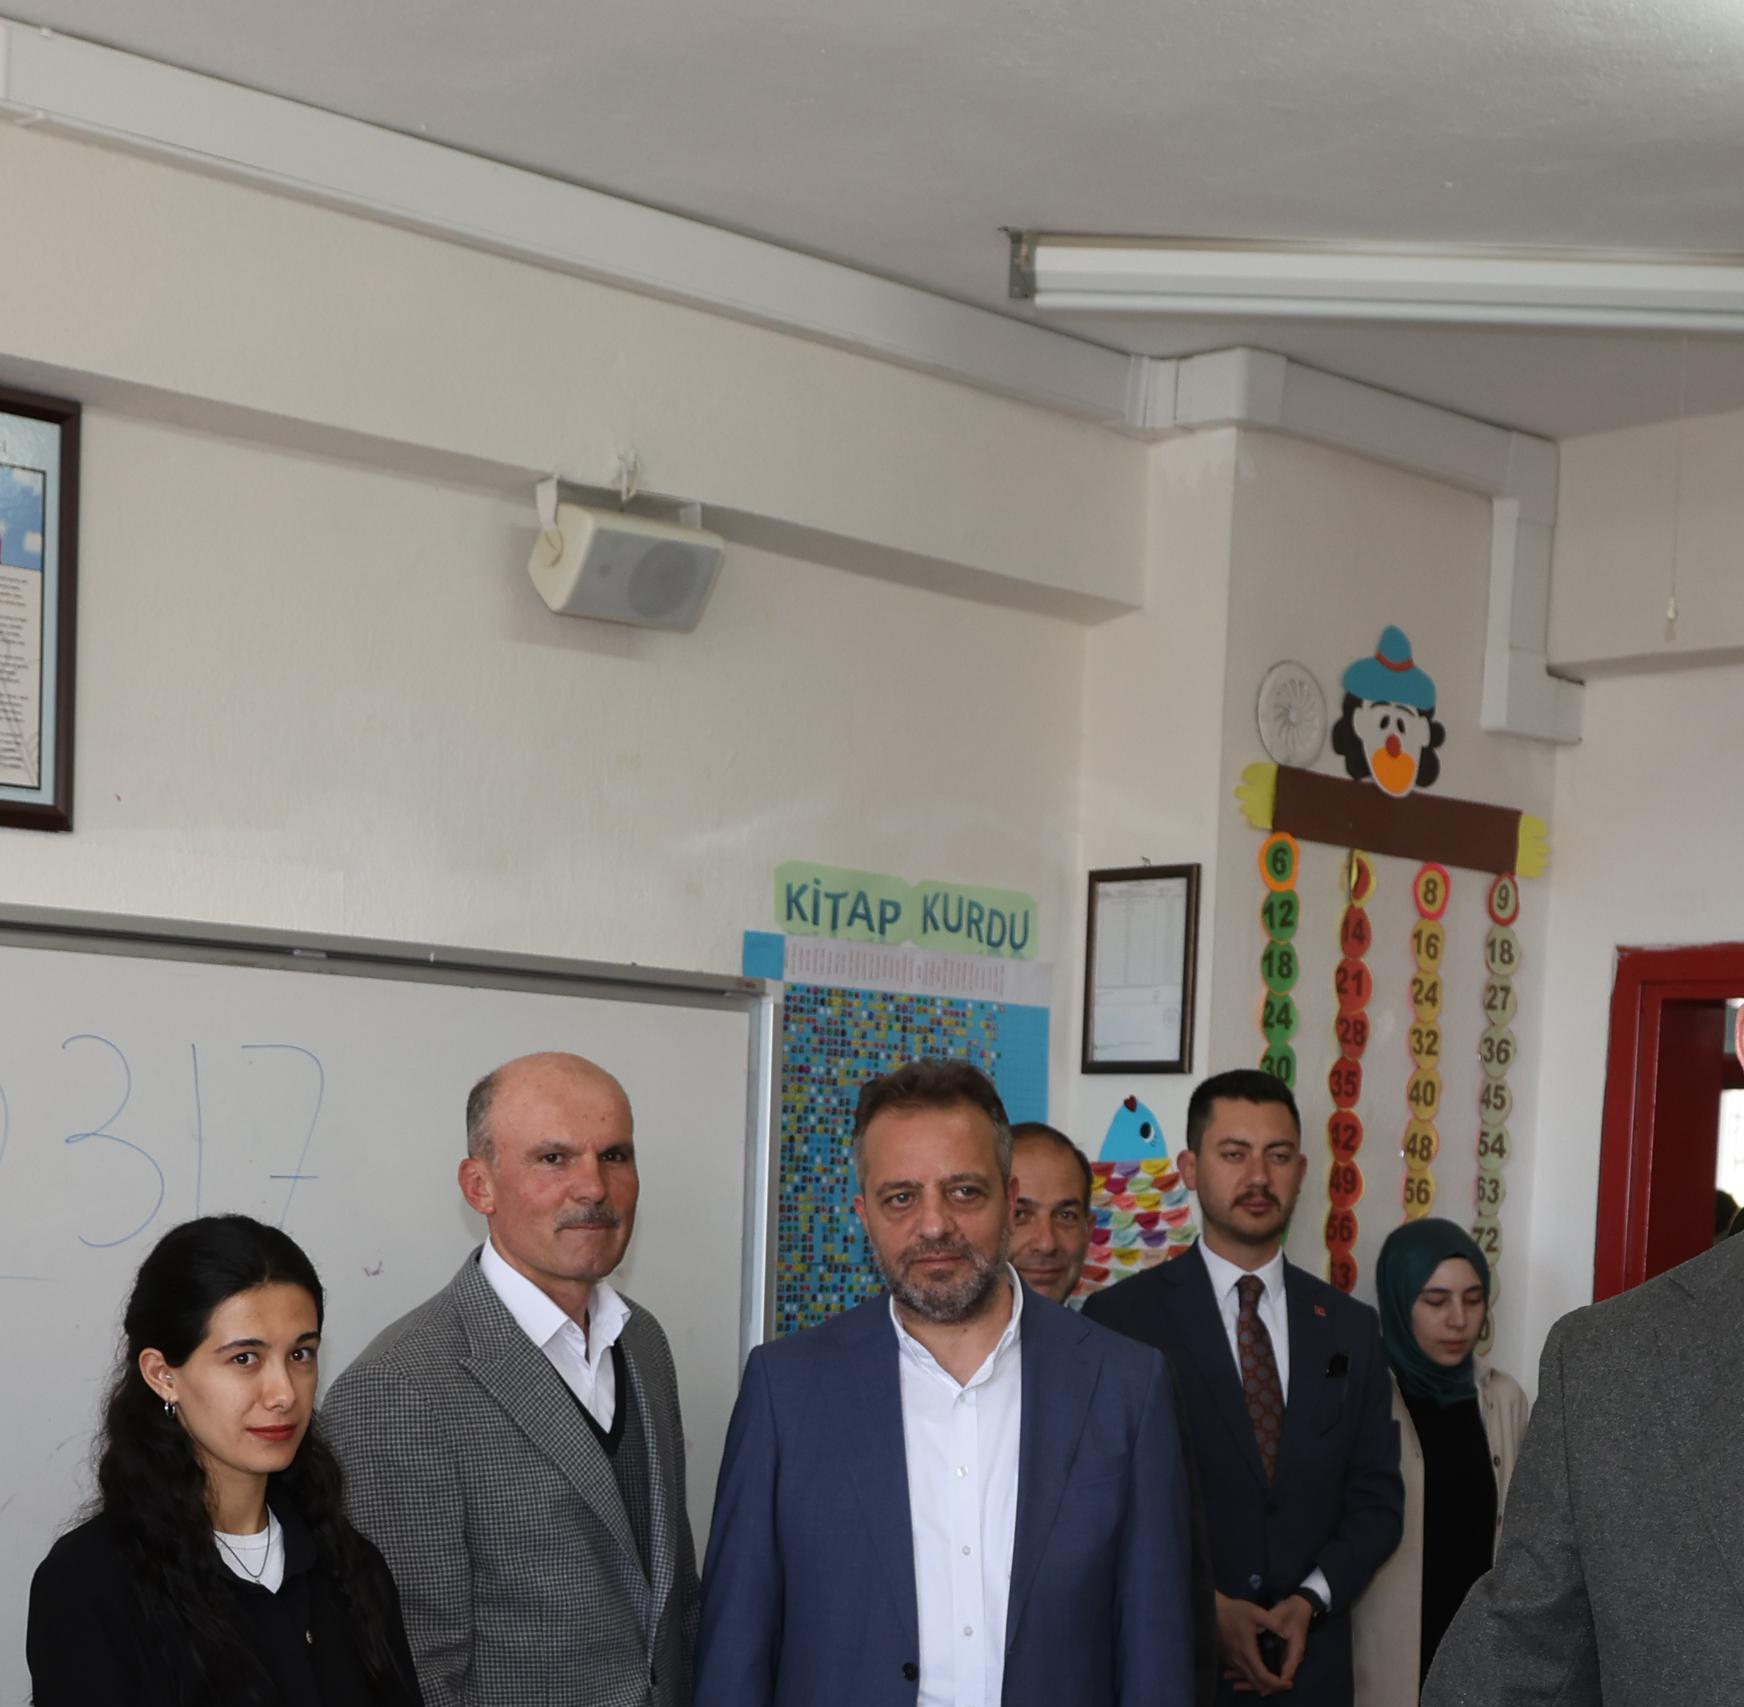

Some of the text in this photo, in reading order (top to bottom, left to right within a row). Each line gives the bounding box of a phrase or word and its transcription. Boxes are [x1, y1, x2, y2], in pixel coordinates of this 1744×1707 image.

[1272, 847, 1288, 876] 6
[1423, 878, 1439, 905] 8
[1496, 885, 1510, 910] 9
[784, 878, 902, 944] KİTAP
[921, 891, 1031, 952] KURDU
[1263, 899, 1295, 929] 12
[1343, 917, 1366, 944] 14
[1412, 928, 1440, 960] 16
[1262, 950, 1293, 979] 18
[1488, 938, 1515, 965] 18
[1336, 967, 1364, 997] 21
[1412, 977, 1439, 1008] 24
[1485, 984, 1512, 1011] 27
[1263, 1001, 1293, 1030] 24
[1338, 1016, 1367, 1048] 28
[1411, 1028, 1439, 1057] 32
[1482, 1036, 1511, 1065] 36
[1330, 1070, 1358, 1098] 35
[1408, 1079, 1436, 1107] 40
[1480, 1083, 1506, 1110] 45
[0, 1034, 325, 1281] 317
[1406, 1132, 1434, 1162] 48
[1478, 1131, 1507, 1158] 54
[1329, 1165, 1357, 1195] 49
